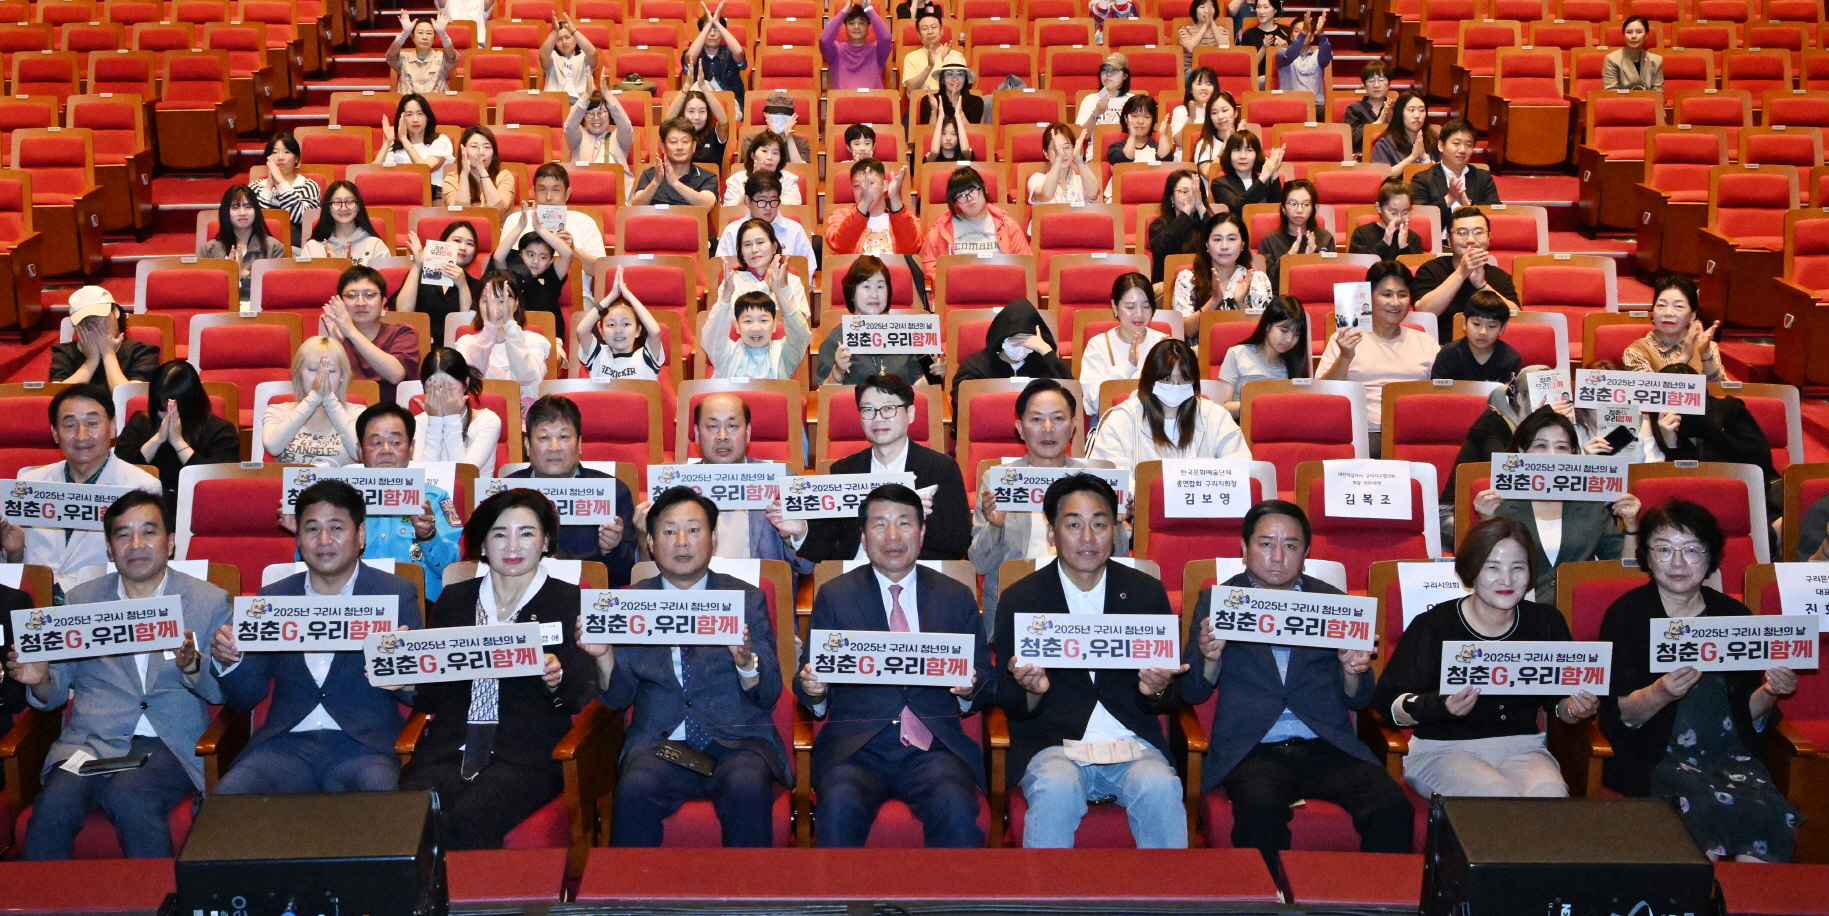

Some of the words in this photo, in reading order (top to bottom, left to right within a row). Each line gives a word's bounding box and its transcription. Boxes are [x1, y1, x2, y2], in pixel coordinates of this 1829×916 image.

[954, 242, 1000, 250] ENMARK
[866, 322, 888, 330] 2025년
[889, 322, 906, 330] 구리시
[908, 322, 925, 330] 청년의
[926, 322, 932, 330] 날
[1606, 378, 1636, 386] 2025년
[1637, 379, 1660, 388] 구리시
[1662, 381, 1686, 389] 청년의
[1688, 382, 1696, 390] 날
[1524, 464, 1555, 472] 2025년
[1558, 464, 1581, 472] 구리시
[1584, 465, 1608, 473] 청년의
[1610, 465, 1618, 473] 날
[351, 478, 376, 486] 구리시
[378, 478, 403, 486] 청년의
[405, 478, 414, 486] 날
[681, 474, 712, 482] 2025년
[714, 474, 738, 482] 구리시
[766, 473, 775, 481] 날
[543, 488, 567, 496] 구리시
[569, 488, 594, 496] 청년의
[596, 488, 604, 496] 날
[812, 483, 842, 492] 2025년
[34, 490, 64, 500] 2025년
[67, 492, 92, 501] 구리시
[621, 602, 656, 611] 2025년
[660, 602, 688, 611] 구리시
[691, 602, 719, 611] 청년의
[722, 602, 731, 611] 날
[1251, 600, 1287, 611] 2025년
[1290, 602, 1319, 614] 구리시
[1322, 605, 1350, 616] 청년의
[1354, 608, 1364, 617] 날
[274, 608, 310, 616] 2025년
[313, 607, 341, 616] 구리시
[344, 607, 373, 616] 청년의
[376, 607, 385, 616] 날
[54, 615, 91, 626] 2025년
[94, 611, 123, 623] 구리시
[126, 610, 156, 620] 청년의
[159, 608, 168, 616] 날
[1054, 625, 1090, 634] 2025년
[1094, 625, 1122, 634] 구리시
[1125, 626, 1153, 635] 청년의
[1156, 626, 1166, 635] 날
[1692, 628, 1728, 638] 2025년
[1732, 628, 1760, 637] 구리시
[1764, 627, 1793, 636] 청년의
[1796, 626, 1806, 635] 날
[407, 641, 446, 651] 2025년
[449, 638, 479, 648] 구리시
[482, 636, 514, 646] 청년의
[516, 635, 526, 644] 날
[850, 642, 886, 652] 2025년
[889, 644, 918, 652] 구리시
[920, 644, 949, 653] 청년의
[952, 645, 961, 654] 날
[1483, 653, 1520, 662] 2025년
[1524, 653, 1553, 662] 구리시
[1556, 653, 1586, 662] 청년의
[1588, 653, 1598, 662] 날
